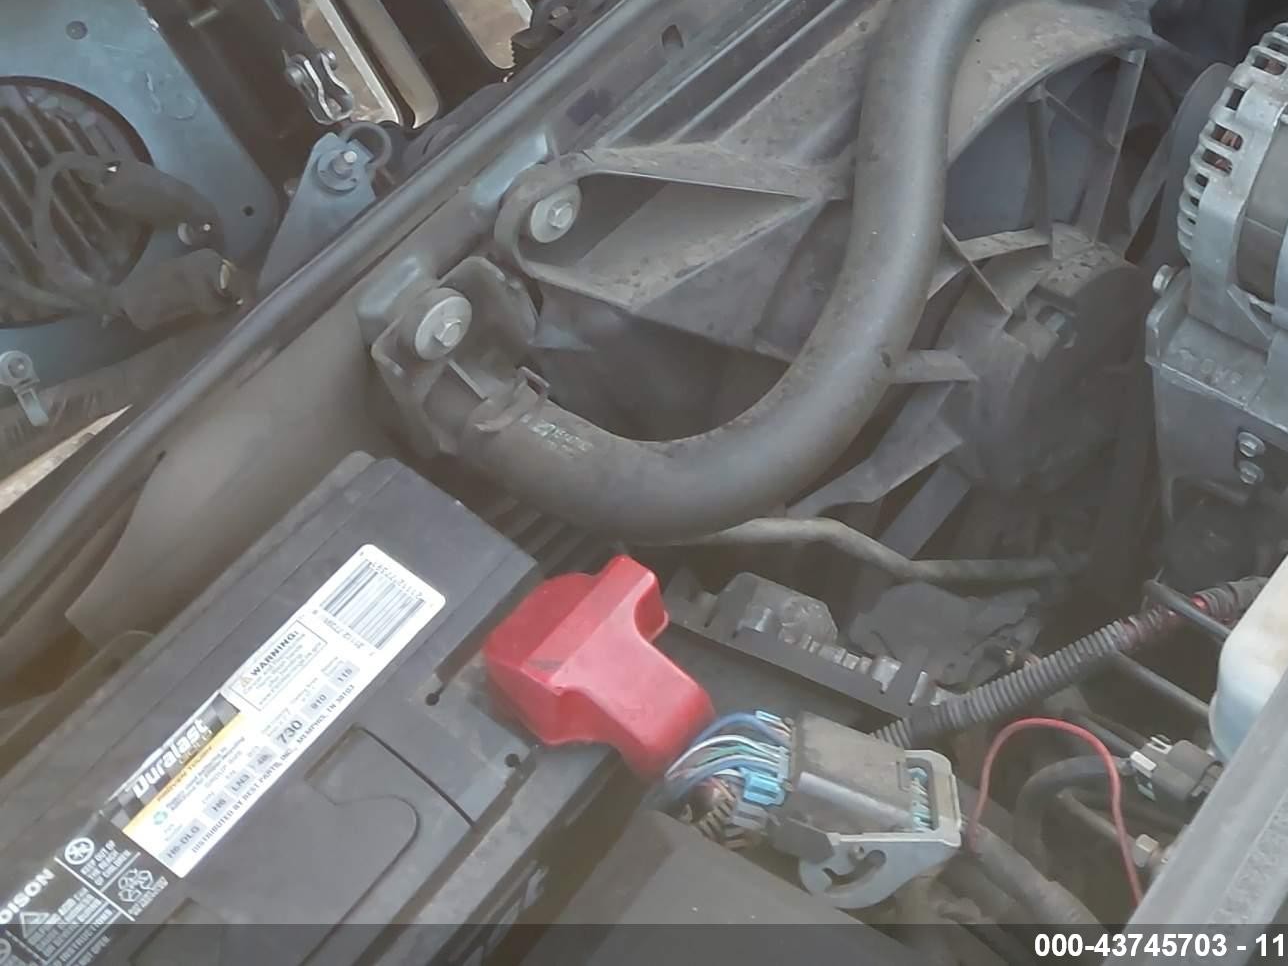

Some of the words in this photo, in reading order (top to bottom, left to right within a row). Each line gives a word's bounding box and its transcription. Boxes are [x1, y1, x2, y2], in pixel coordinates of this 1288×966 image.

[250, 628, 299, 678] WARNING:
[275, 718, 304, 745] 730
[130, 715, 213, 799] Duralast
